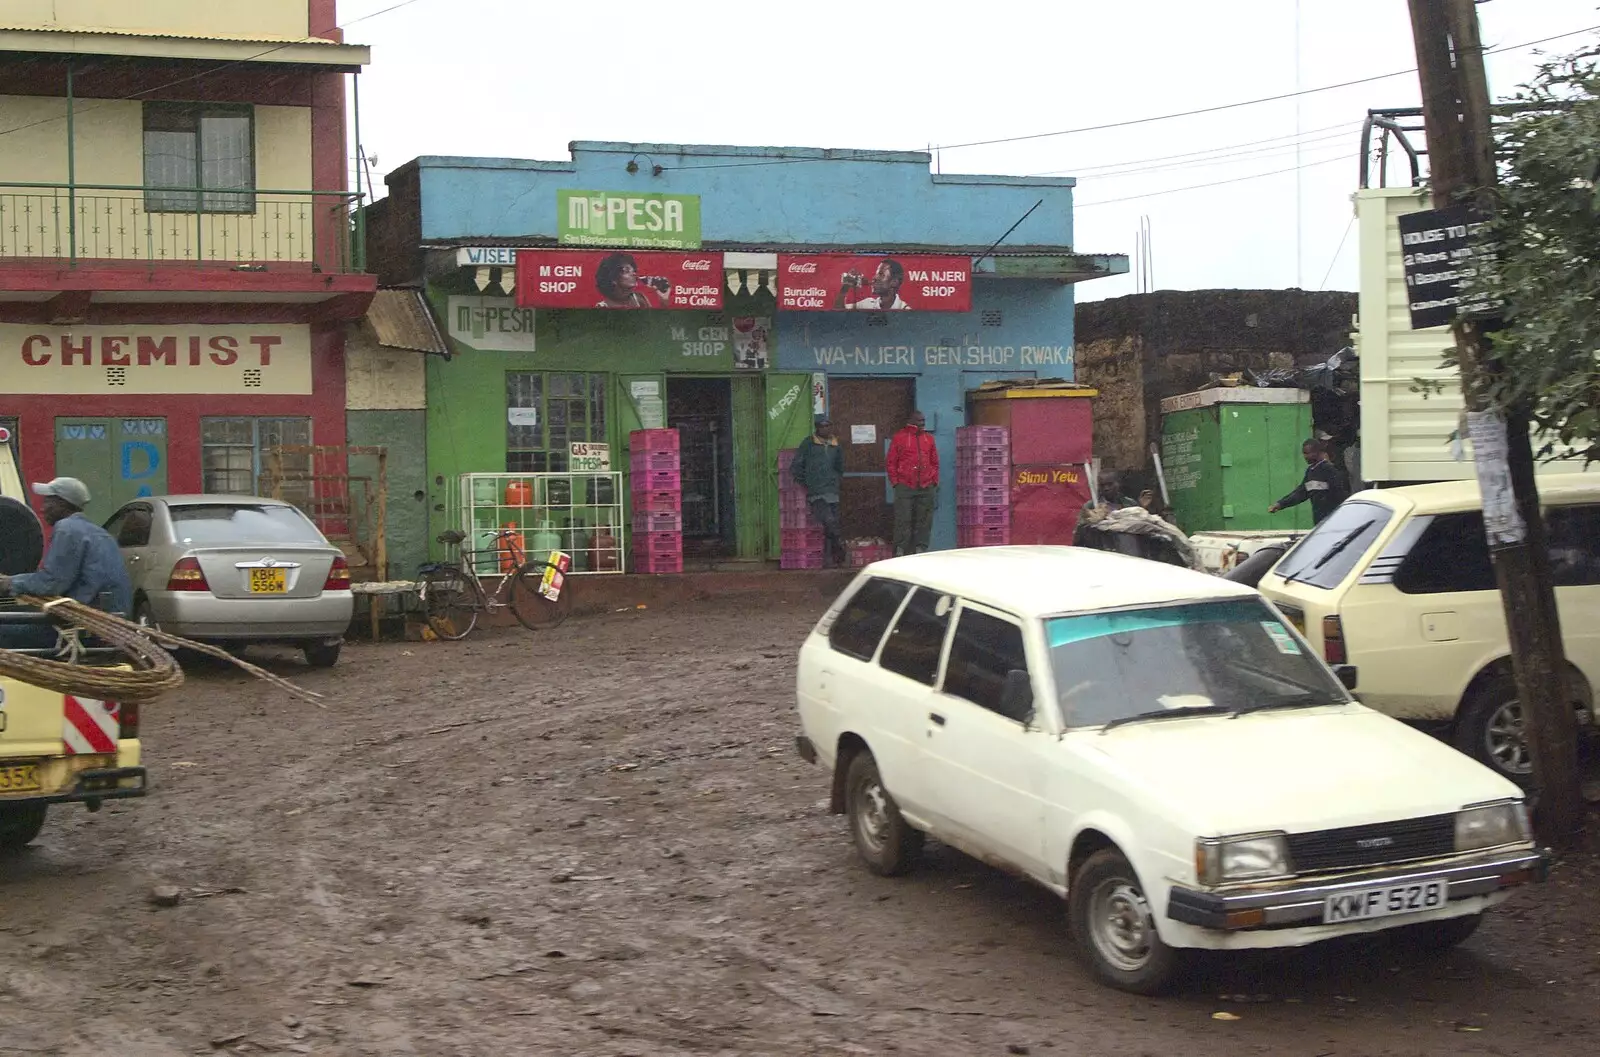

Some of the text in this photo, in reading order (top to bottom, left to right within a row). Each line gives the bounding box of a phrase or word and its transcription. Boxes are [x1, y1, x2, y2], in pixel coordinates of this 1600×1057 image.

[540, 266, 582, 277] M GEN
[909, 270, 966, 283] WA NJERI
[539, 282, 577, 293] SHOP
[675, 285, 719, 295] Burudika
[784, 287, 827, 297] Burudika
[922, 286, 955, 297] SHOP
[675, 295, 717, 306] na Coke
[784, 297, 824, 307] na Coke
[21, 334, 282, 366] CHEMIST
[682, 342, 725, 356] SHOP
[1020, 347, 1074, 365] RWAKA
[571, 444, 588, 456] GAS
[1018, 471, 1048, 484] Simu
[252, 569, 276, 580] KBH
[253, 581, 284, 592] 556W
[1330, 883, 1440, 921] KWF 528
